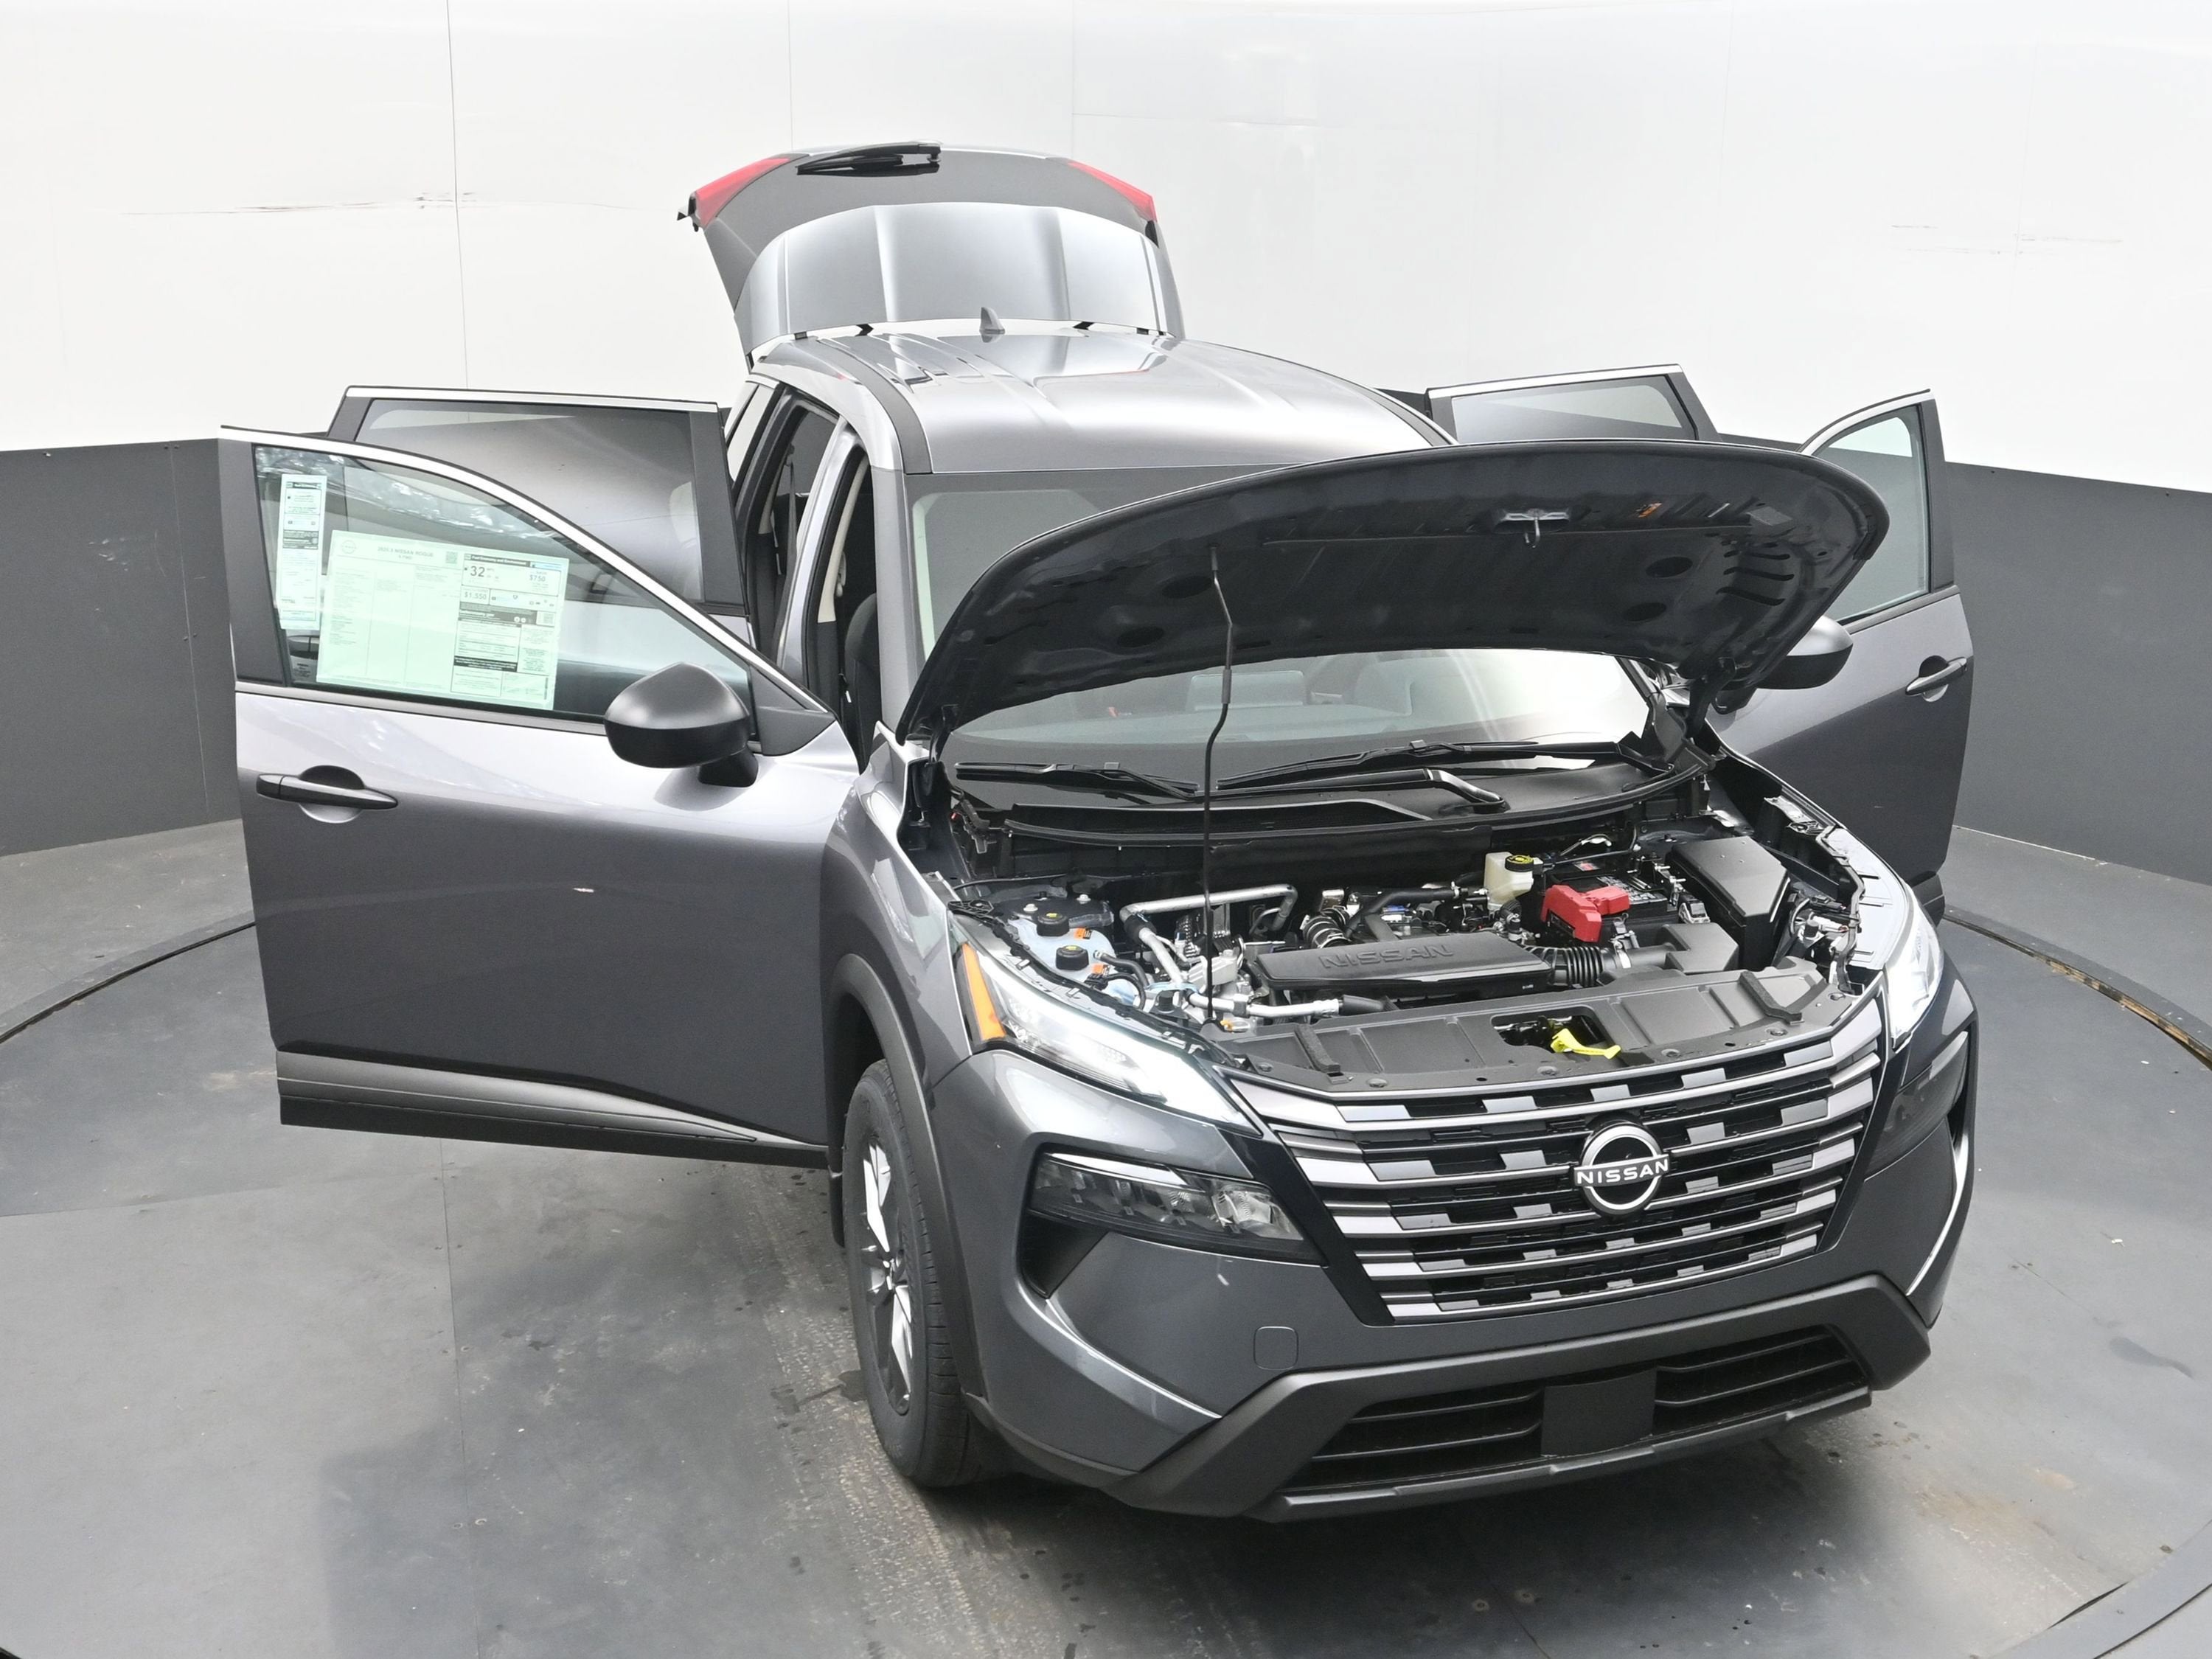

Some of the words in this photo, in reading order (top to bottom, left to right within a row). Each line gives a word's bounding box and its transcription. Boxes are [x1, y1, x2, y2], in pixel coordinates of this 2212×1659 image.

[470, 566, 486, 577] 32
[1319, 945, 1453, 969] NISSAN
[1576, 1158, 1669, 1185] NISSAN
